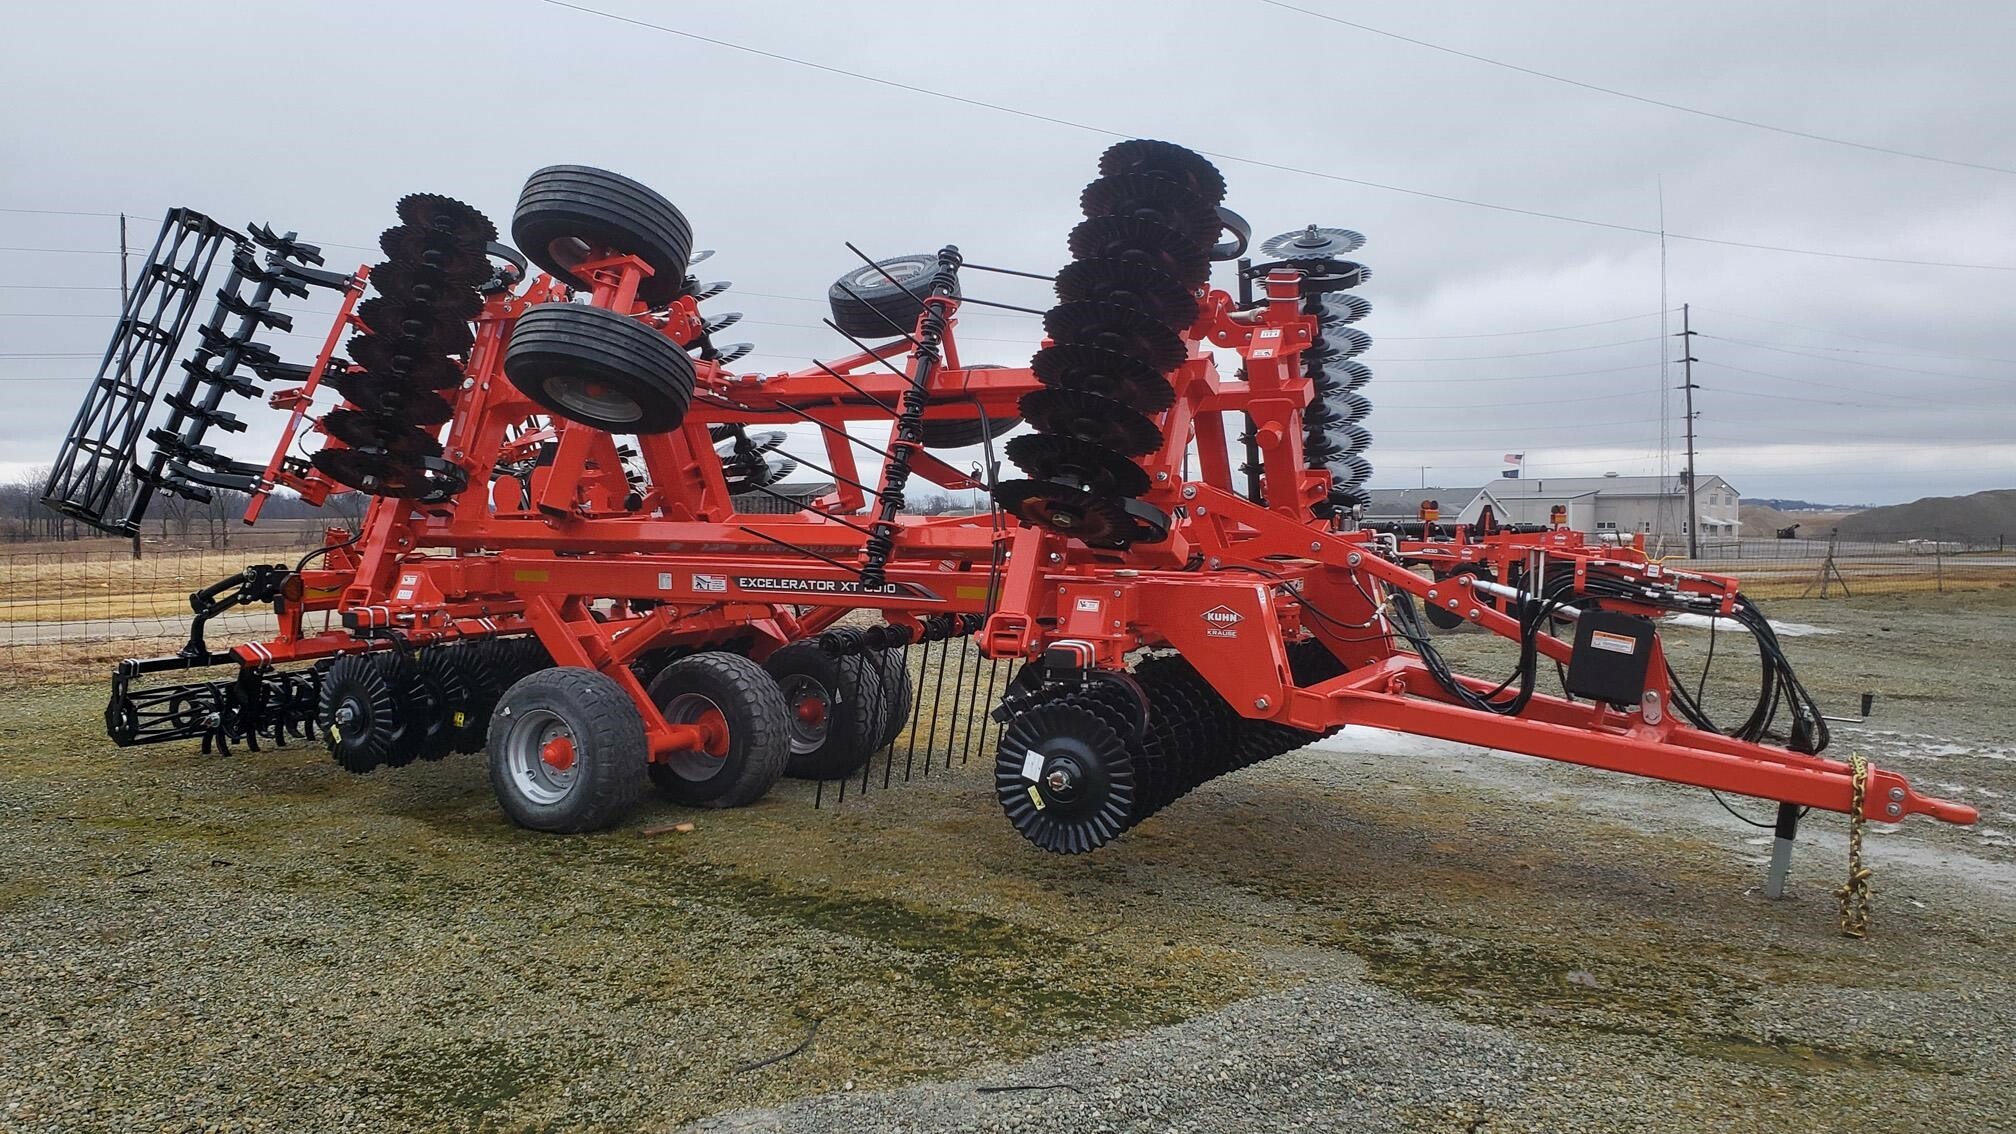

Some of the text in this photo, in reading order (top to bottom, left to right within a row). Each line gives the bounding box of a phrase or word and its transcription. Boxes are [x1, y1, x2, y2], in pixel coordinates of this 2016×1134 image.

[739, 577, 836, 592] EXCELERATOR
[840, 581, 860, 592] XT
[1207, 612, 1237, 622] KUHN
